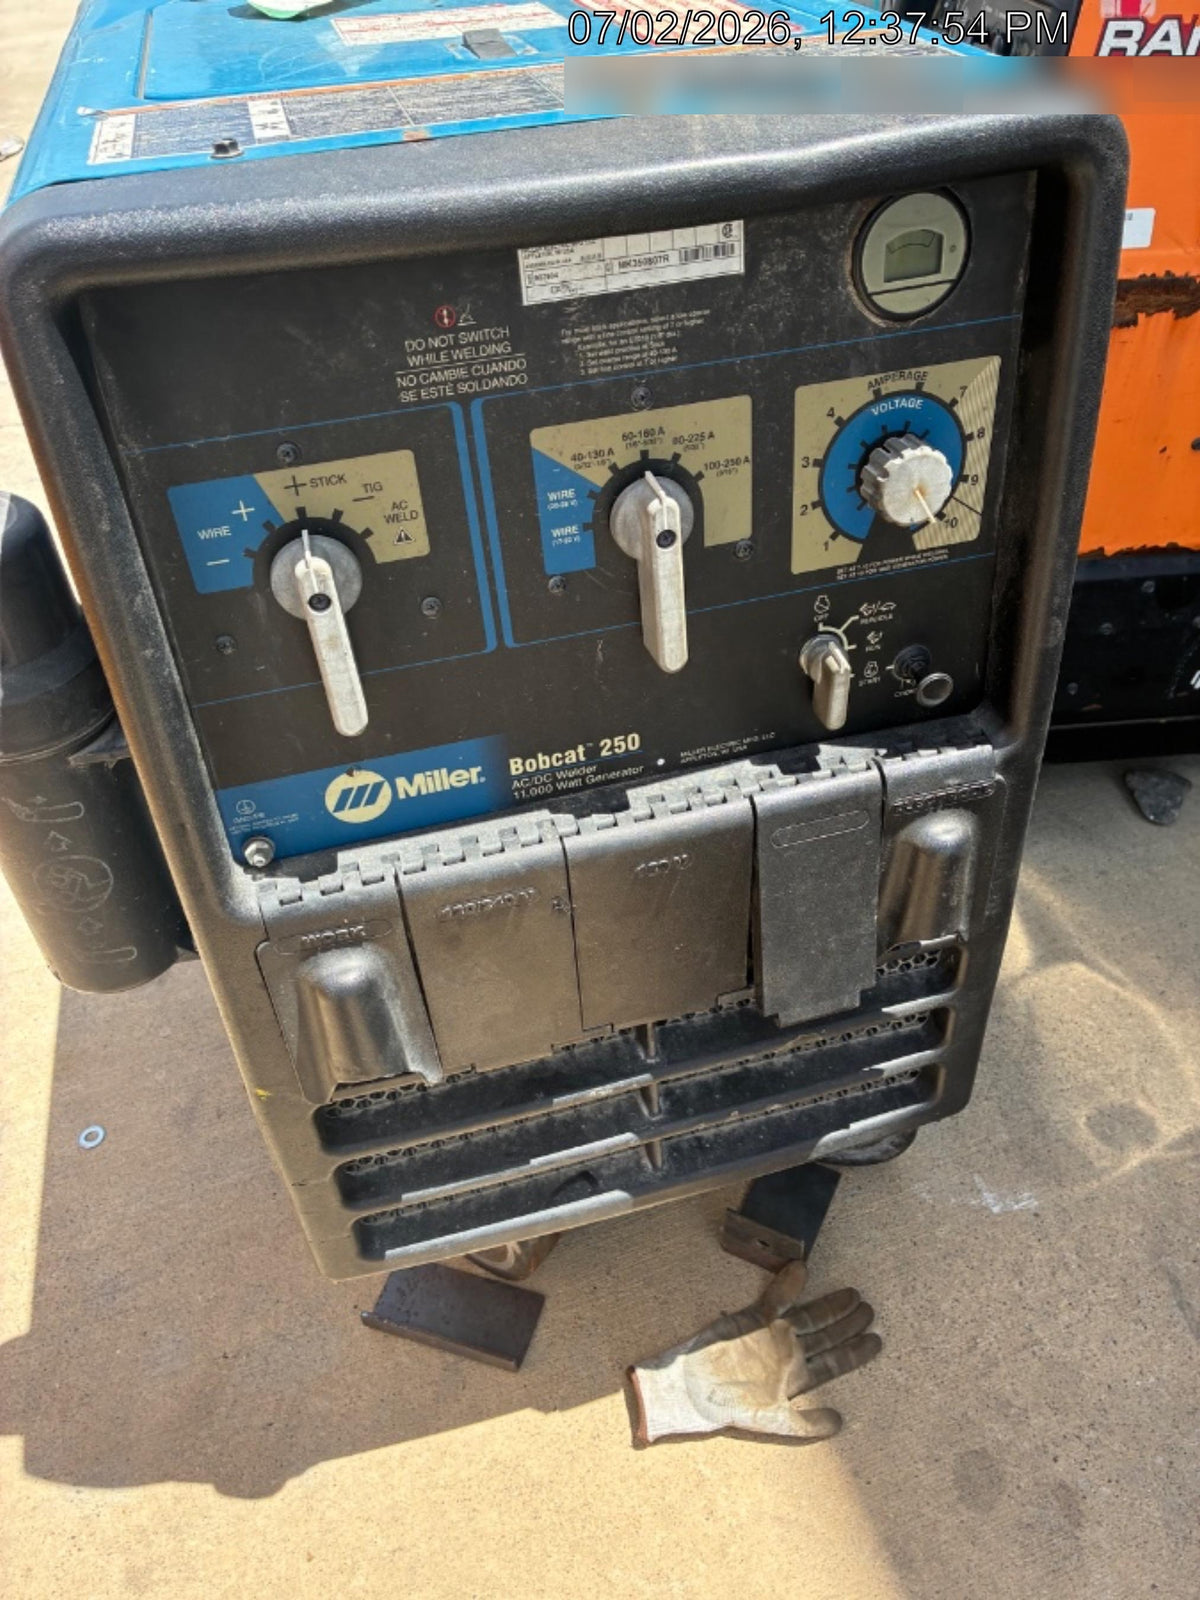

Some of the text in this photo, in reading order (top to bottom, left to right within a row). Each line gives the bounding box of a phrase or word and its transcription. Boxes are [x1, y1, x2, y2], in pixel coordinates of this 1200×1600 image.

[404, 326, 510, 352] DO NOT SWITCH
[407, 341, 512, 367] WHILE WELDING
[396, 358, 527, 388] NO CAMBIE CUANDO
[867, 371, 929, 391] AMPERAGE
[400, 390, 418, 403] SE
[457, 374, 528, 394] SOLDANDO
[959, 385, 968, 397] 7
[826, 407, 835, 418] 4
[870, 399, 924, 416] VOLTAGE
[656, 426, 665, 436] A
[706, 430, 716, 440] A
[977, 427, 985, 439] 8
[570, 447, 615, 462] 40-130 A
[742, 455, 751, 464] A
[801, 456, 810, 468] 3
[309, 473, 347, 488] STICK
[971, 474, 979, 486] 9
[361, 481, 383, 495] TIG
[547, 488, 576, 501] WIRE
[391, 500, 409, 511] AC
[800, 504, 808, 516] 2
[383, 509, 419, 525] WELD
[197, 525, 232, 541] WIRE
[551, 525, 579, 538] WIRE
[823, 540, 830, 551] 1
[599, 733, 641, 757] 250
[395, 766, 482, 800] Miller
[511, 764, 597, 790] AC/DC Welder
[558, 777, 584, 792] Watt
[586, 765, 645, 787] Generator
